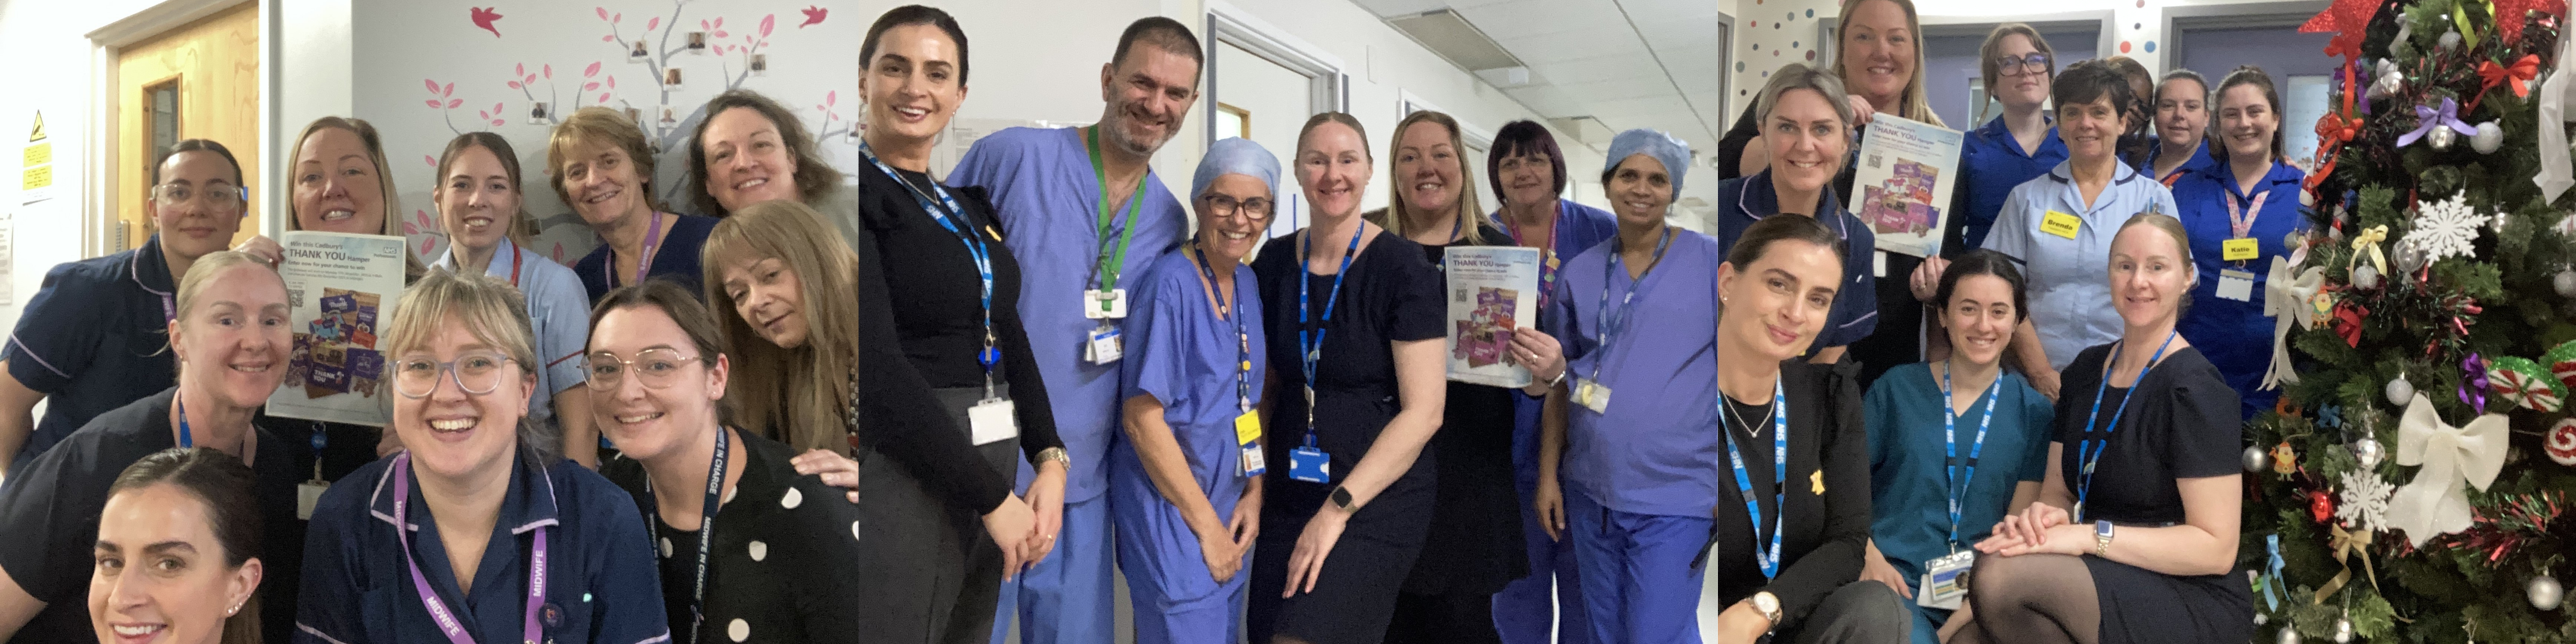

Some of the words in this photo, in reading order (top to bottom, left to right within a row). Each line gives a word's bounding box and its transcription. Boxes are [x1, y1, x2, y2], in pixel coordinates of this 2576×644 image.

[1874, 125, 1899, 137] THANK
[1901, 131, 1917, 141] YOU
[2047, 219, 2073, 231] Brenda
[289, 249, 322, 259] THANK
[324, 251, 346, 261] YOU
[313, 374, 327, 383] YOU
[314, 369, 335, 379] THANK
[1986, 398, 1995, 412] NHS
[1981, 414, 1990, 428] NHS
[1976, 430, 1985, 444] NHS
[716, 450, 724, 459] IN
[1730, 450, 1743, 469] NHS
[1776, 446, 1785, 465] NHS
[709, 459, 723, 496] CHARGE
[701, 516, 711, 553] MIDWIFE
[699, 553, 707, 564] IN
[1770, 543, 1780, 563] NHS
[532, 550, 544, 597] MIDWIFE
[695, 565, 705, 601] CHARGE
[426, 596, 460, 636] MIDWIFE
